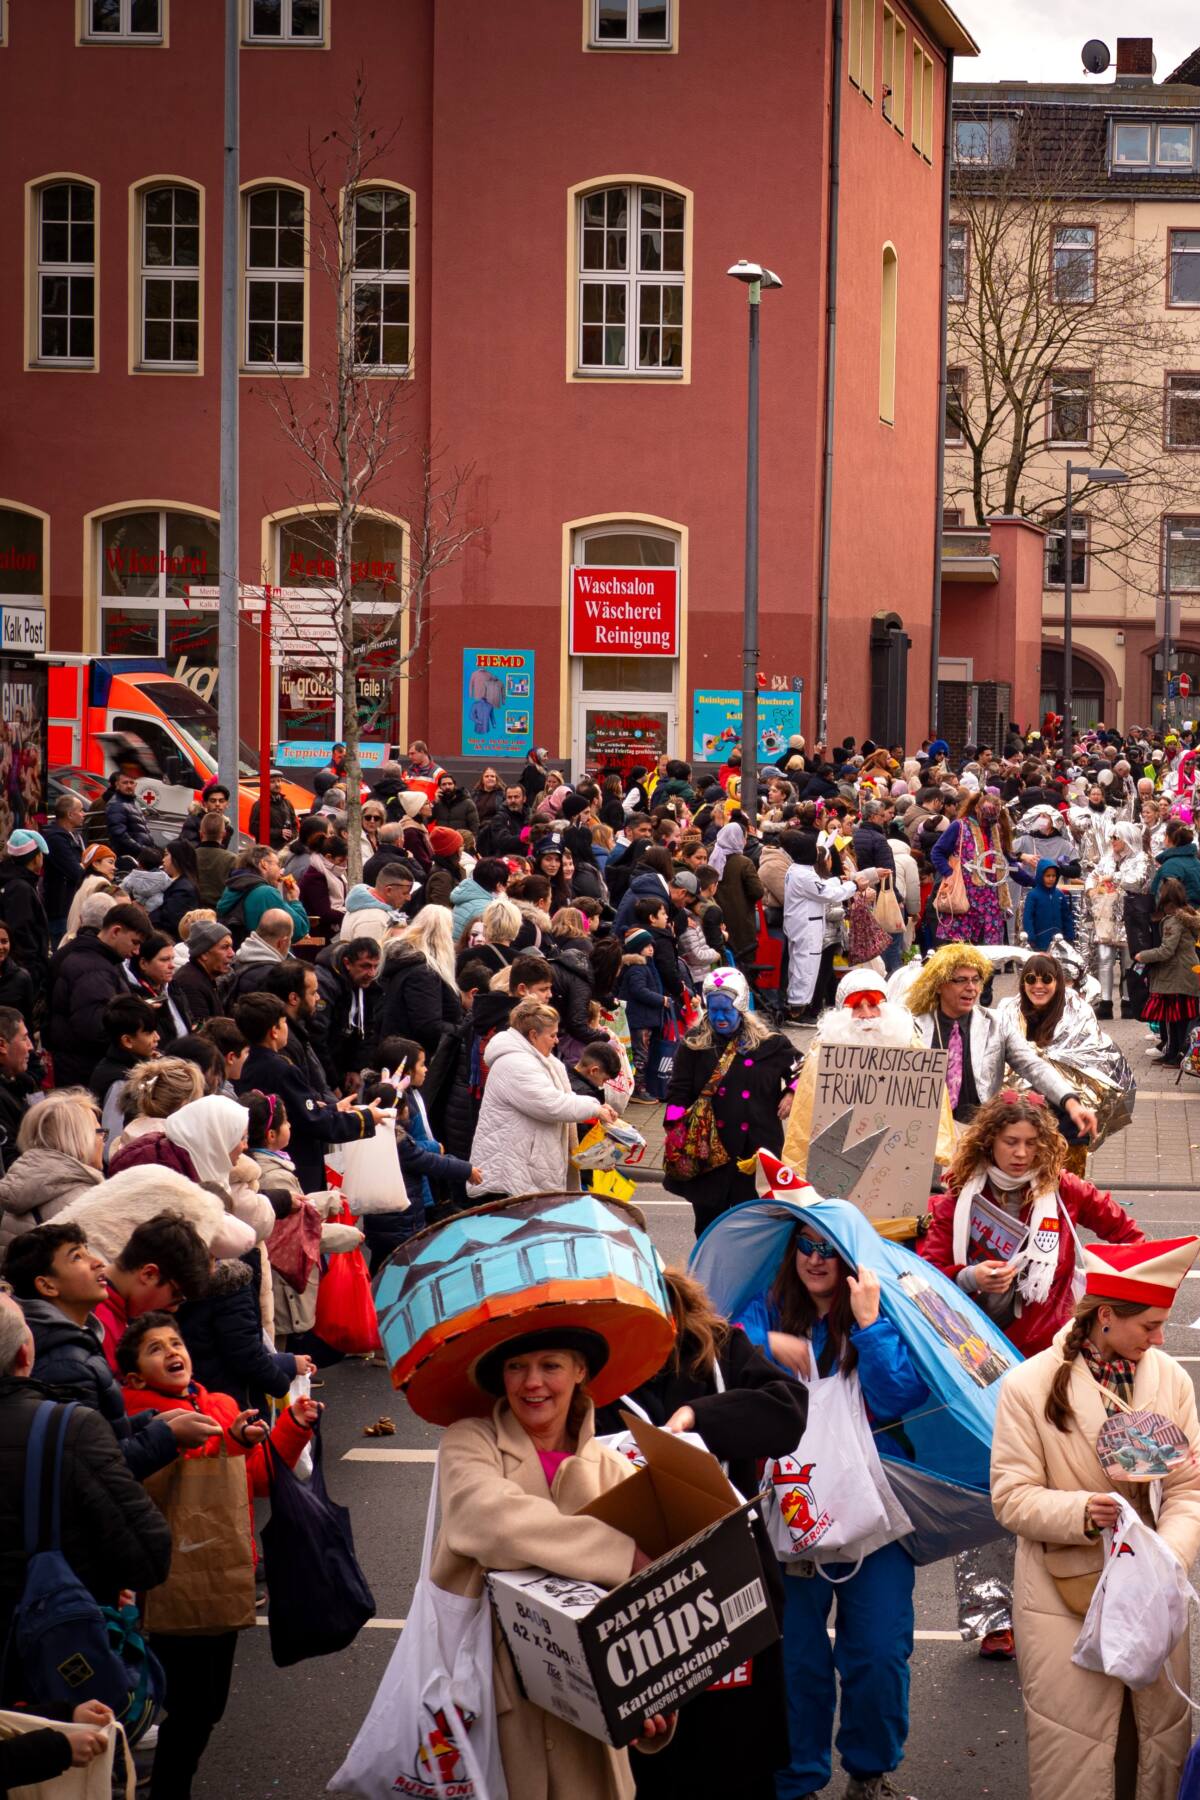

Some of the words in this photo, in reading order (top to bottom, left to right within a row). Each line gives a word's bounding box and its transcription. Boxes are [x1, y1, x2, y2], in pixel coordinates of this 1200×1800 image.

[577, 576, 655, 595] Waschsalon
[585, 600, 662, 620] Wäscherei
[4, 615, 22, 642] Kalk
[24, 617, 43, 644] Post
[595, 625, 670, 649] Reinigung
[476, 654, 525, 668] HEMD
[281, 675, 295, 695] für
[297, 672, 334, 700] große
[358, 678, 381, 697] Teile
[821, 1045, 947, 1074] FUTURISTISCHE
[596, 1560, 708, 1642] PAPRIKA
[515, 1601, 552, 1635] 840g
[512, 1621, 531, 1642] 42
[532, 1632, 543, 1649] x
[543, 1637, 571, 1665] 20g
[617, 1636, 731, 1721] Kartoffelchips
[643, 1690, 679, 1719] KNUSPRIG
[678, 1684, 687, 1696] &
[685, 1665, 713, 1690] WÜRZIG
